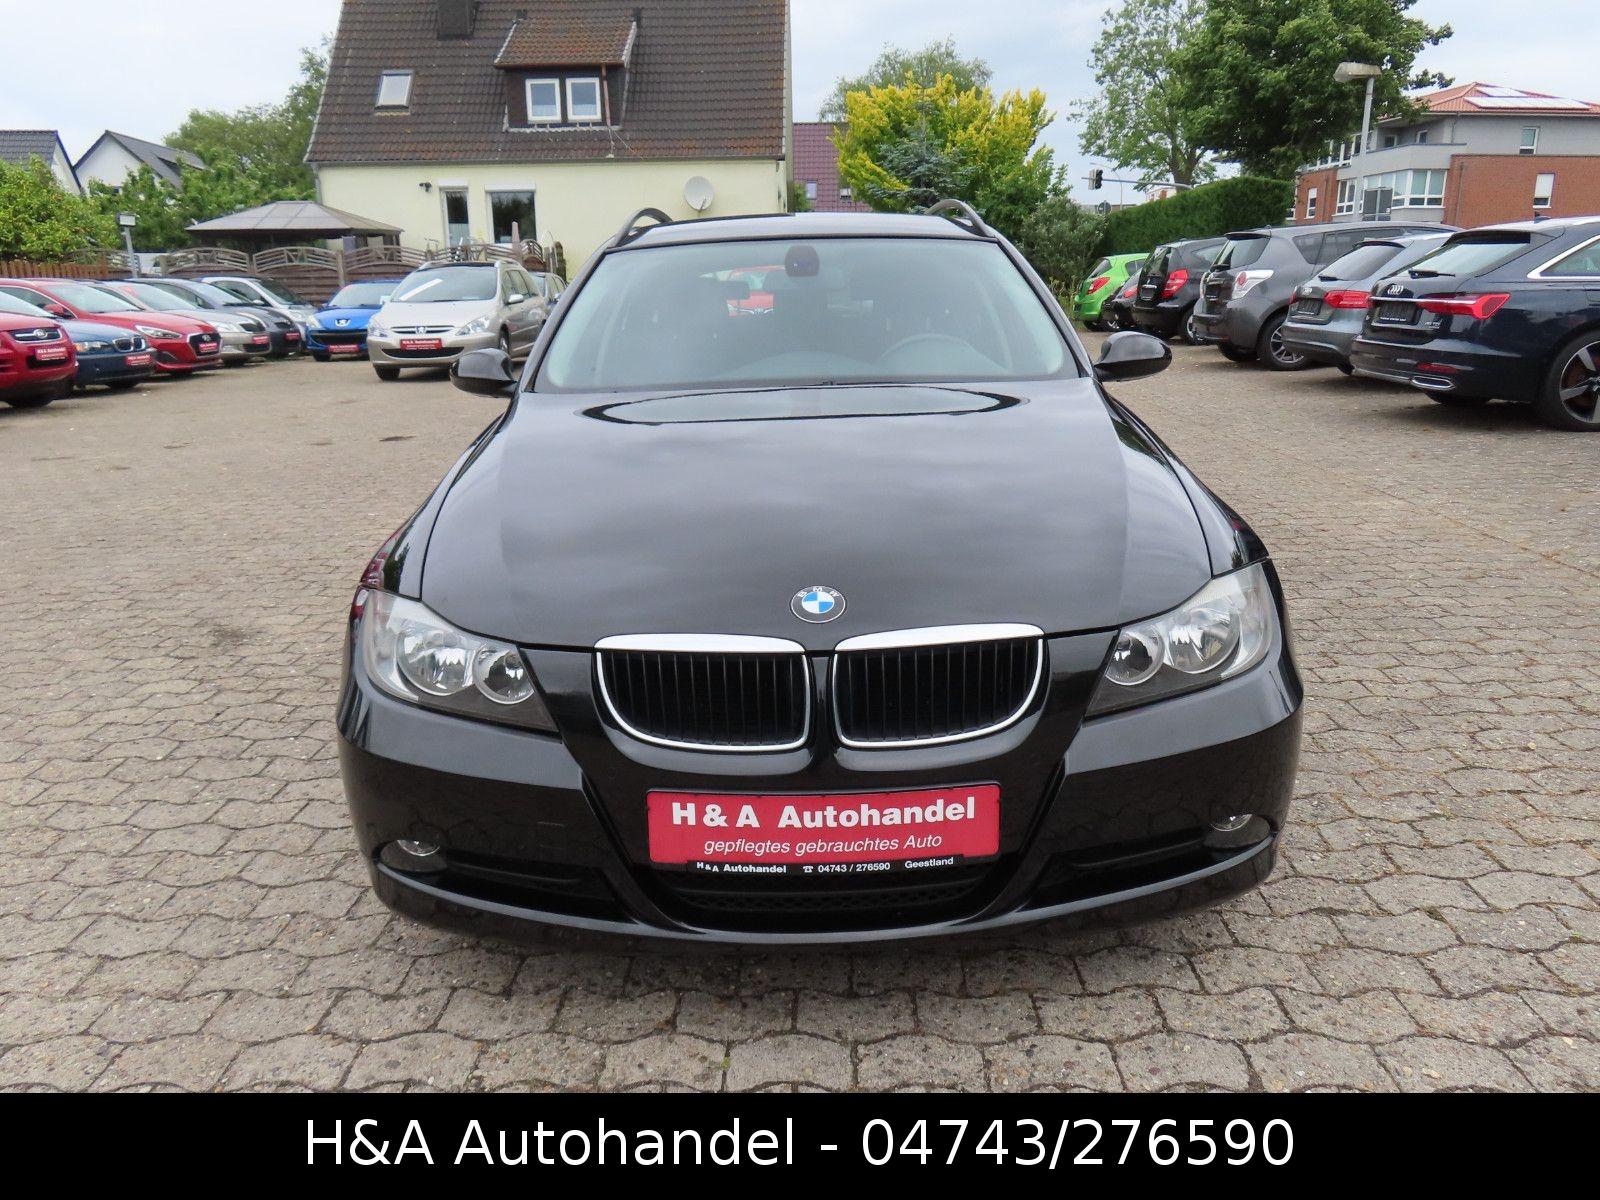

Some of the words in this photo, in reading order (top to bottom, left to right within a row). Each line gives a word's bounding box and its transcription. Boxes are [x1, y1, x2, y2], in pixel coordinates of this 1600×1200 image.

[797, 585, 840, 598] BMW
[777, 796, 976, 829] Autohandel
[704, 838, 791, 857] gepflegtes
[794, 837, 900, 857] gebrauchtes
[903, 834, 942, 849] Auto
[722, 863, 787, 874] Autohandel
[817, 864, 848, 873] 04743
[855, 861, 891, 872] 276590
[904, 857, 954, 869] Geestland
